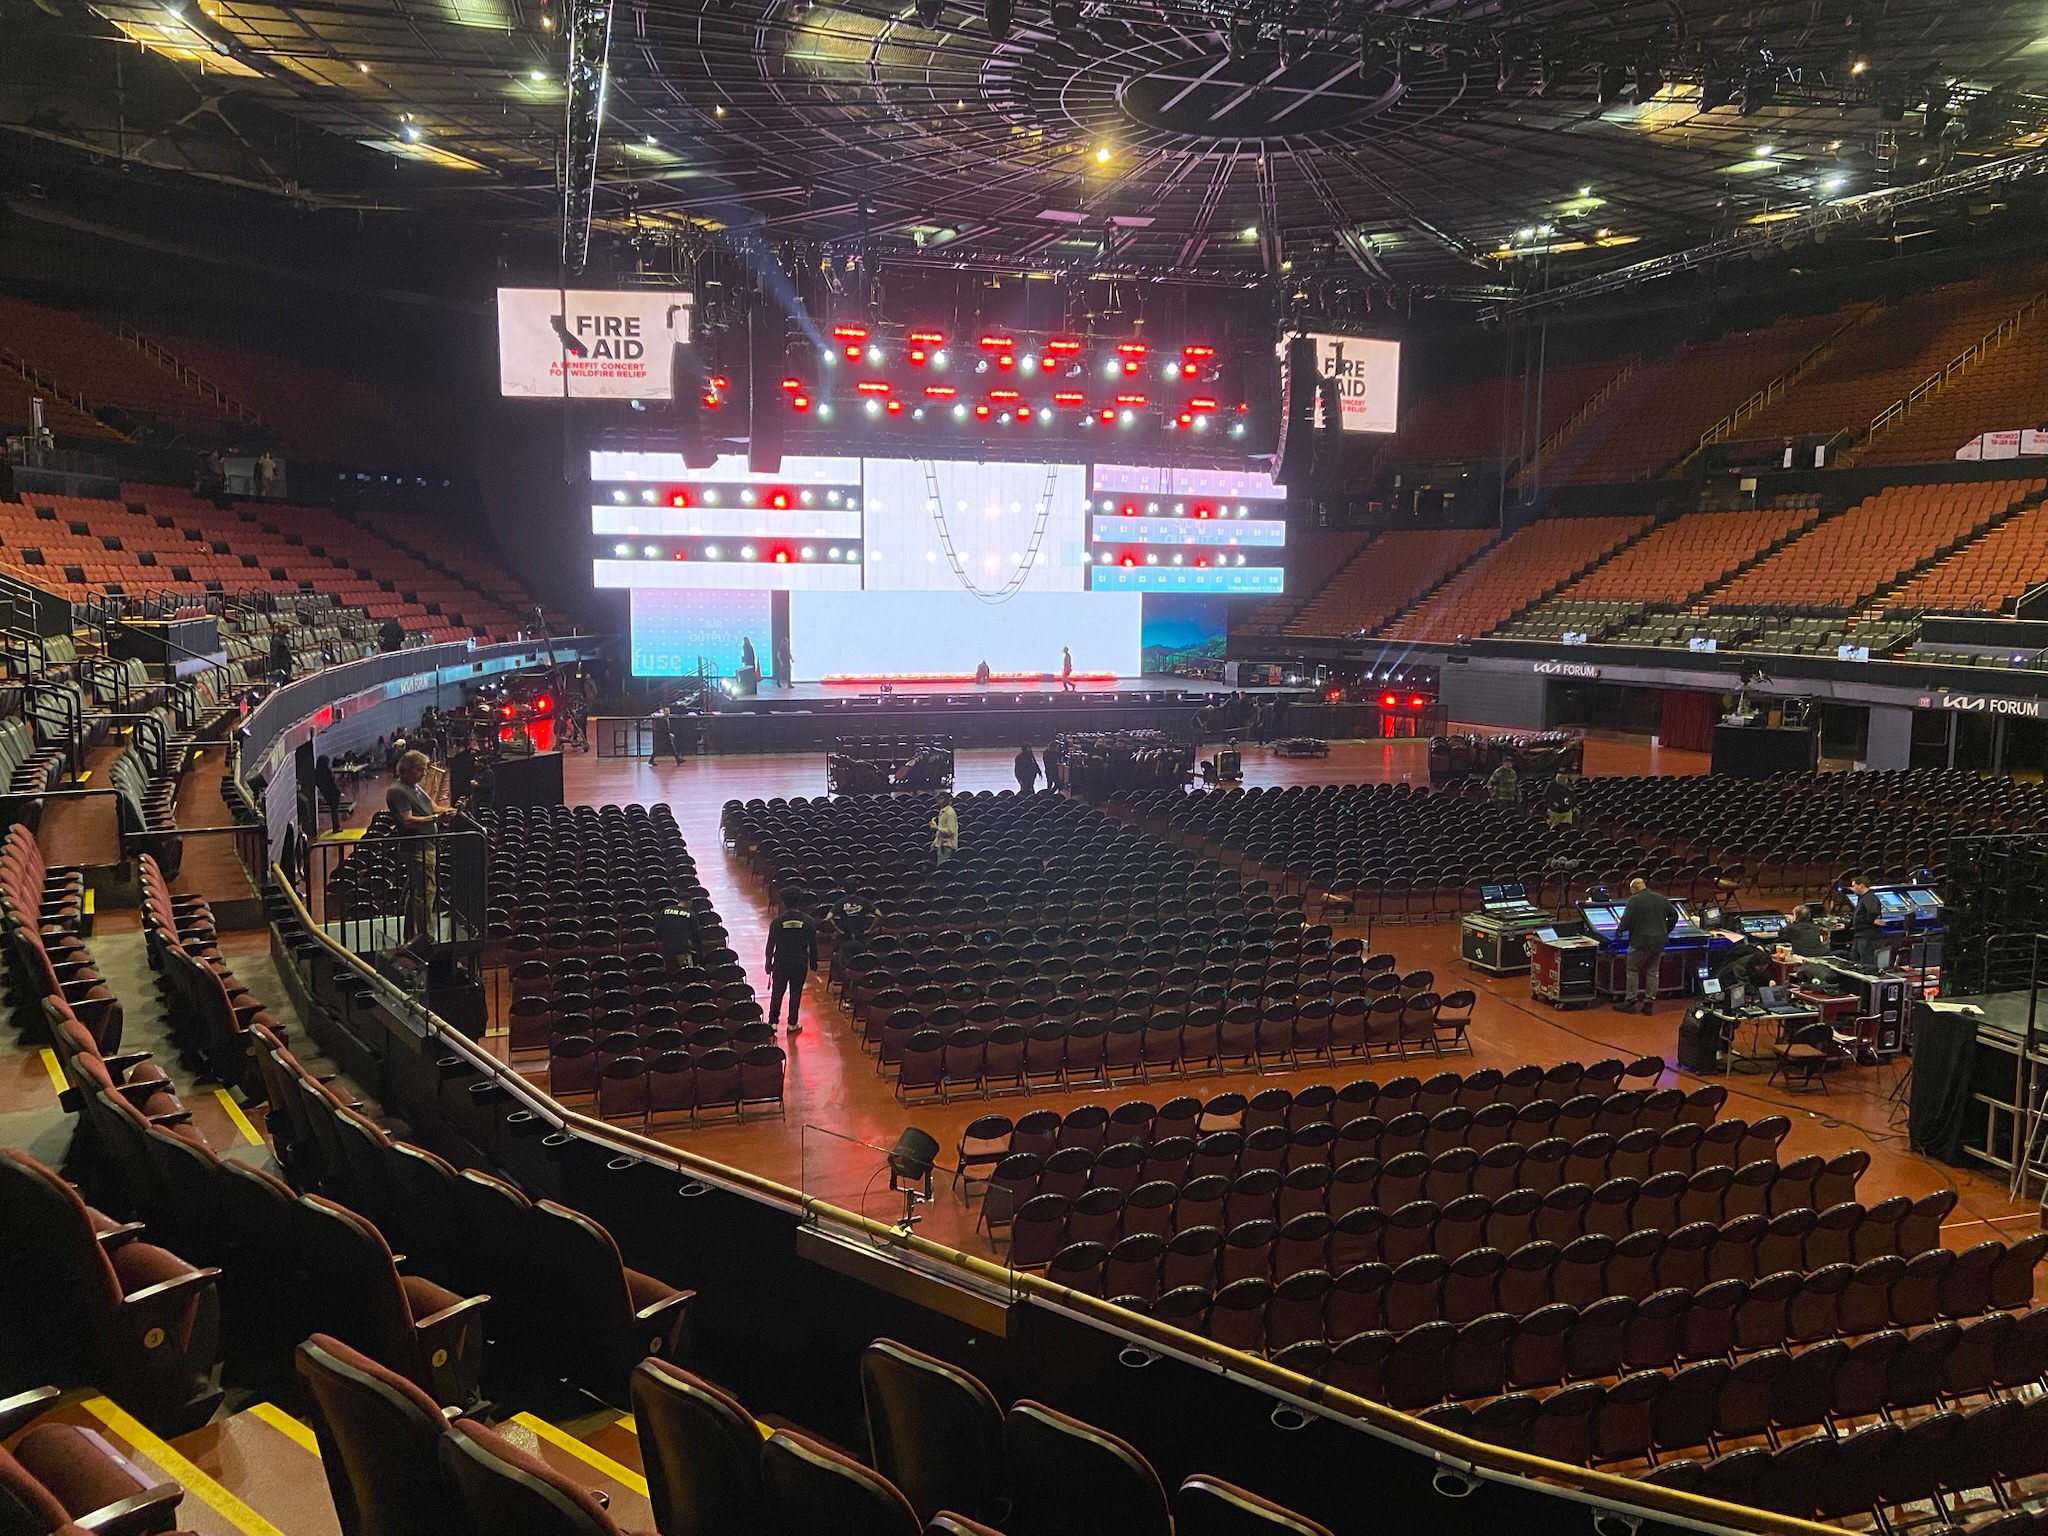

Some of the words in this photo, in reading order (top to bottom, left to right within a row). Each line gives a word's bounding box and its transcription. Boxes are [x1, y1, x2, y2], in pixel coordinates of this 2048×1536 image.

[577, 316, 640, 337] FIRE
[592, 340, 644, 360] AID
[571, 370, 615, 378] WILDFIRE
[690, 633, 731, 643] OUTPUT
[633, 647, 682, 670] fuse
[1533, 663, 1560, 673] KIA
[1564, 665, 1594, 676] FORUM
[1943, 695, 1985, 710] KIA
[1989, 699, 2039, 716] FORUM
